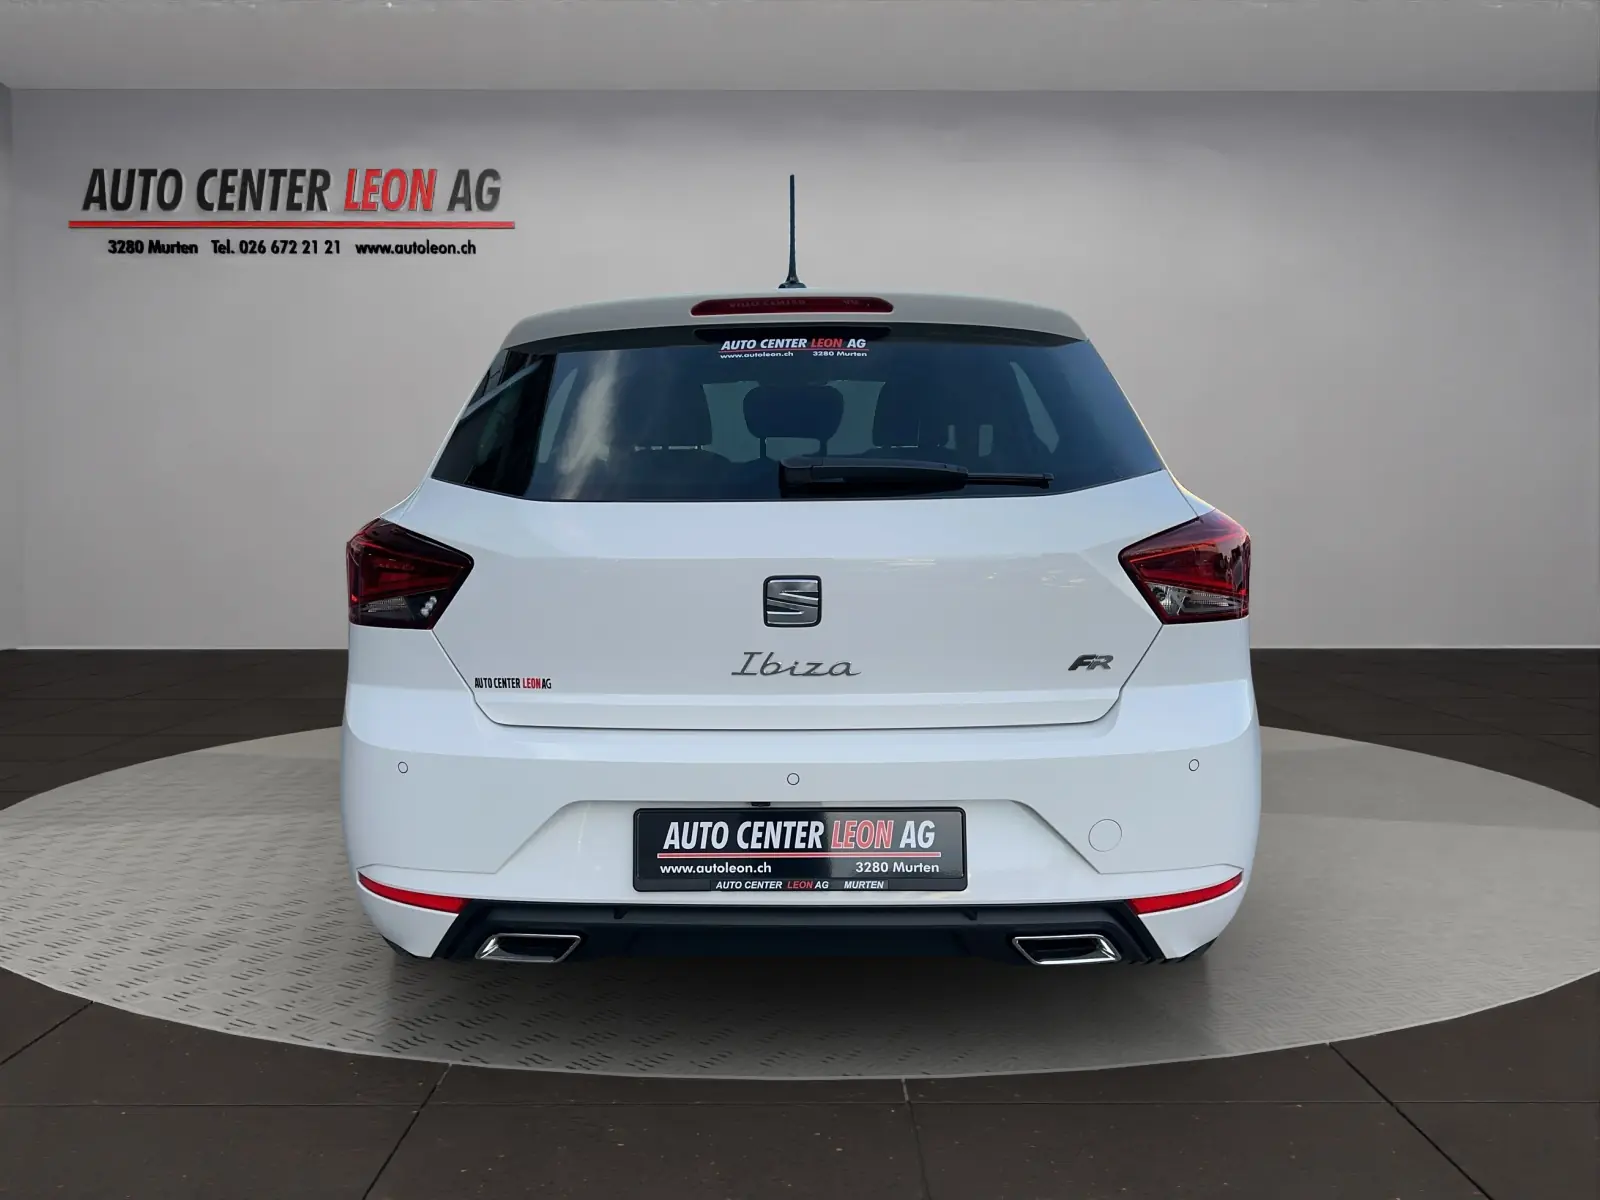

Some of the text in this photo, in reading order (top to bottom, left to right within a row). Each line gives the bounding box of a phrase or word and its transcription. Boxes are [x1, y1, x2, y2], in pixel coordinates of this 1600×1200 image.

[82, 168, 502, 212] AUTO CENTER LEON AG
[108, 239, 477, 255] 3280 Murten Tel. 026 672 21 21 www.autoleon.ch
[721, 338, 867, 350] AUTO CENTER LEON AG
[720, 351, 794, 359] www.autoleon.ch
[731, 652, 861, 676] Ibiza
[1068, 654, 1114, 671] FR
[475, 677, 552, 689] AUTO CENTER LEON AG
[663, 820, 935, 849] AUTO CENTER LEON AG
[660, 861, 940, 874] www.autoleon.ch 3280 Murten
[716, 880, 884, 889] AUTO CENTER LEON AG MURTEN
